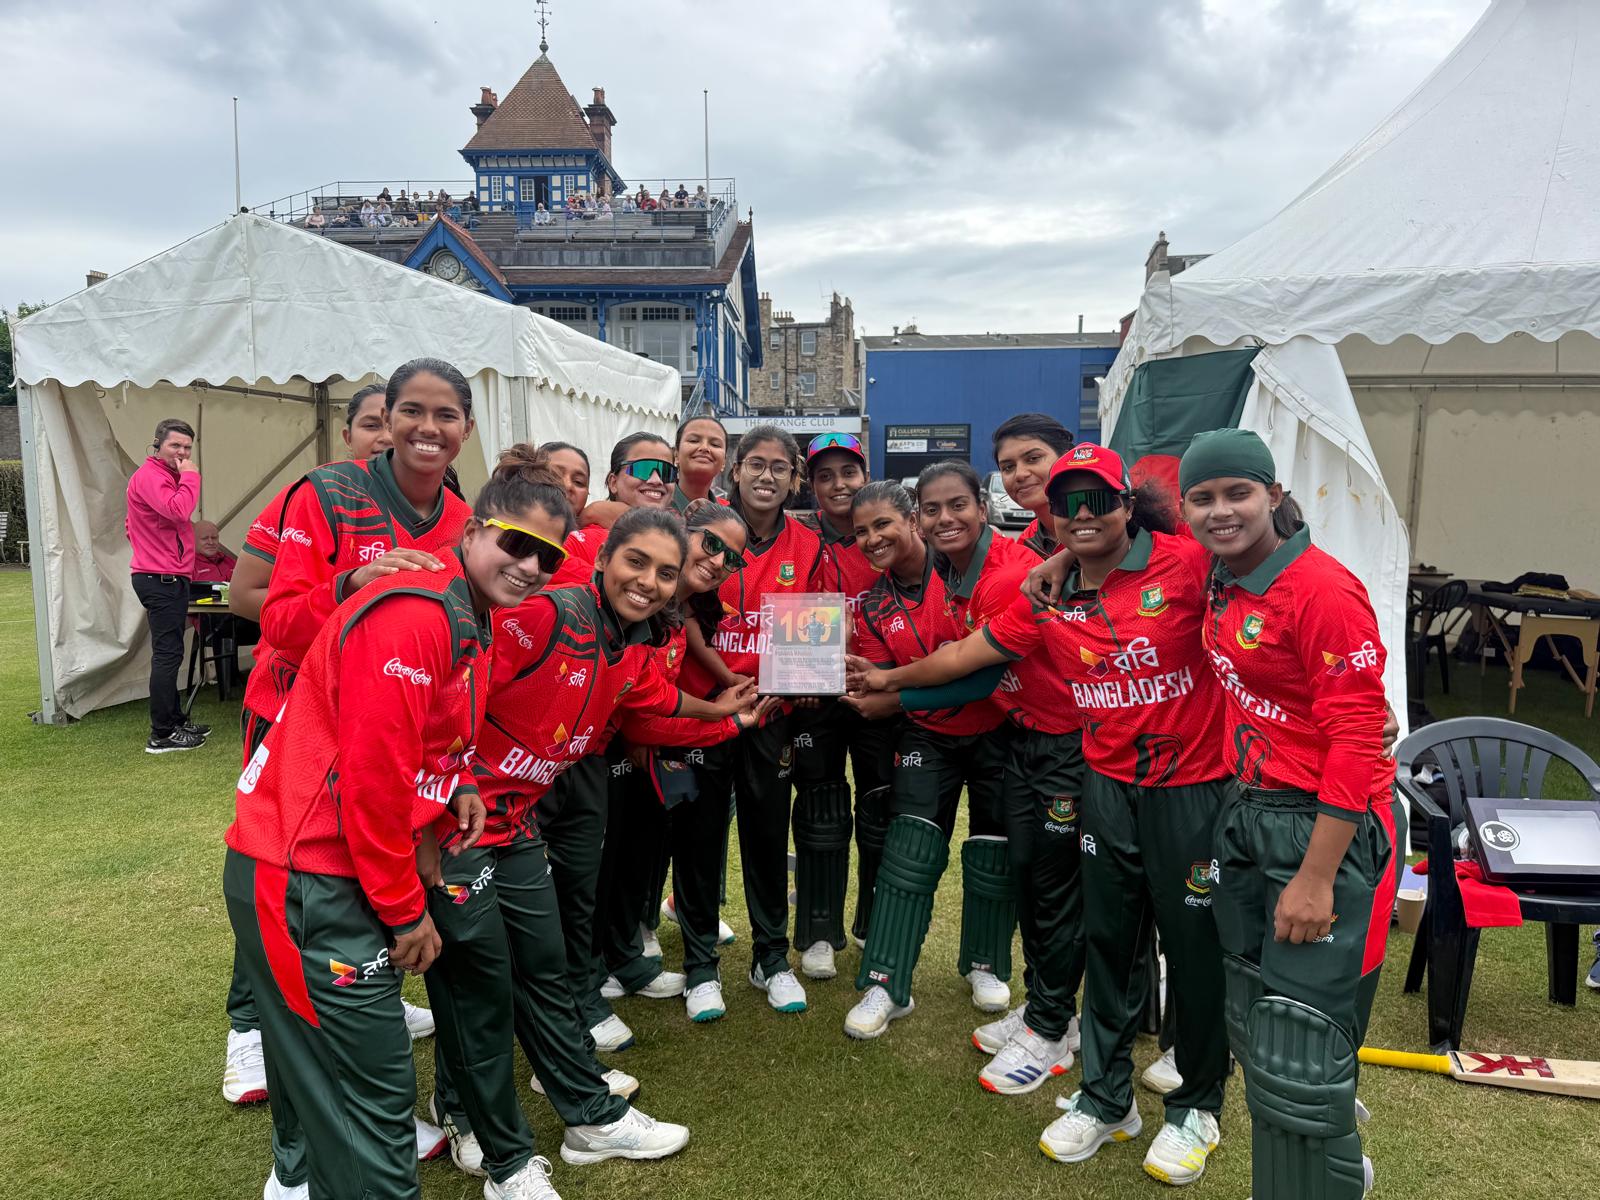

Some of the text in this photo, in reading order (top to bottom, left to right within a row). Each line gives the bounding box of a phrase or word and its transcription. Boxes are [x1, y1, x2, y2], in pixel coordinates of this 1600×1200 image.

[744, 418, 835, 428] THE GRANGE CLUB
[1063, 606, 1087, 623] রবি
[1109, 637, 1160, 675] রবি
[1348, 641, 1378, 672] রবি
[568, 668, 587, 688] রবি
[1072, 666, 1194, 709] BANGLADESH
[902, 751, 922, 768] রবি
[869, 969, 889, 983] SF
